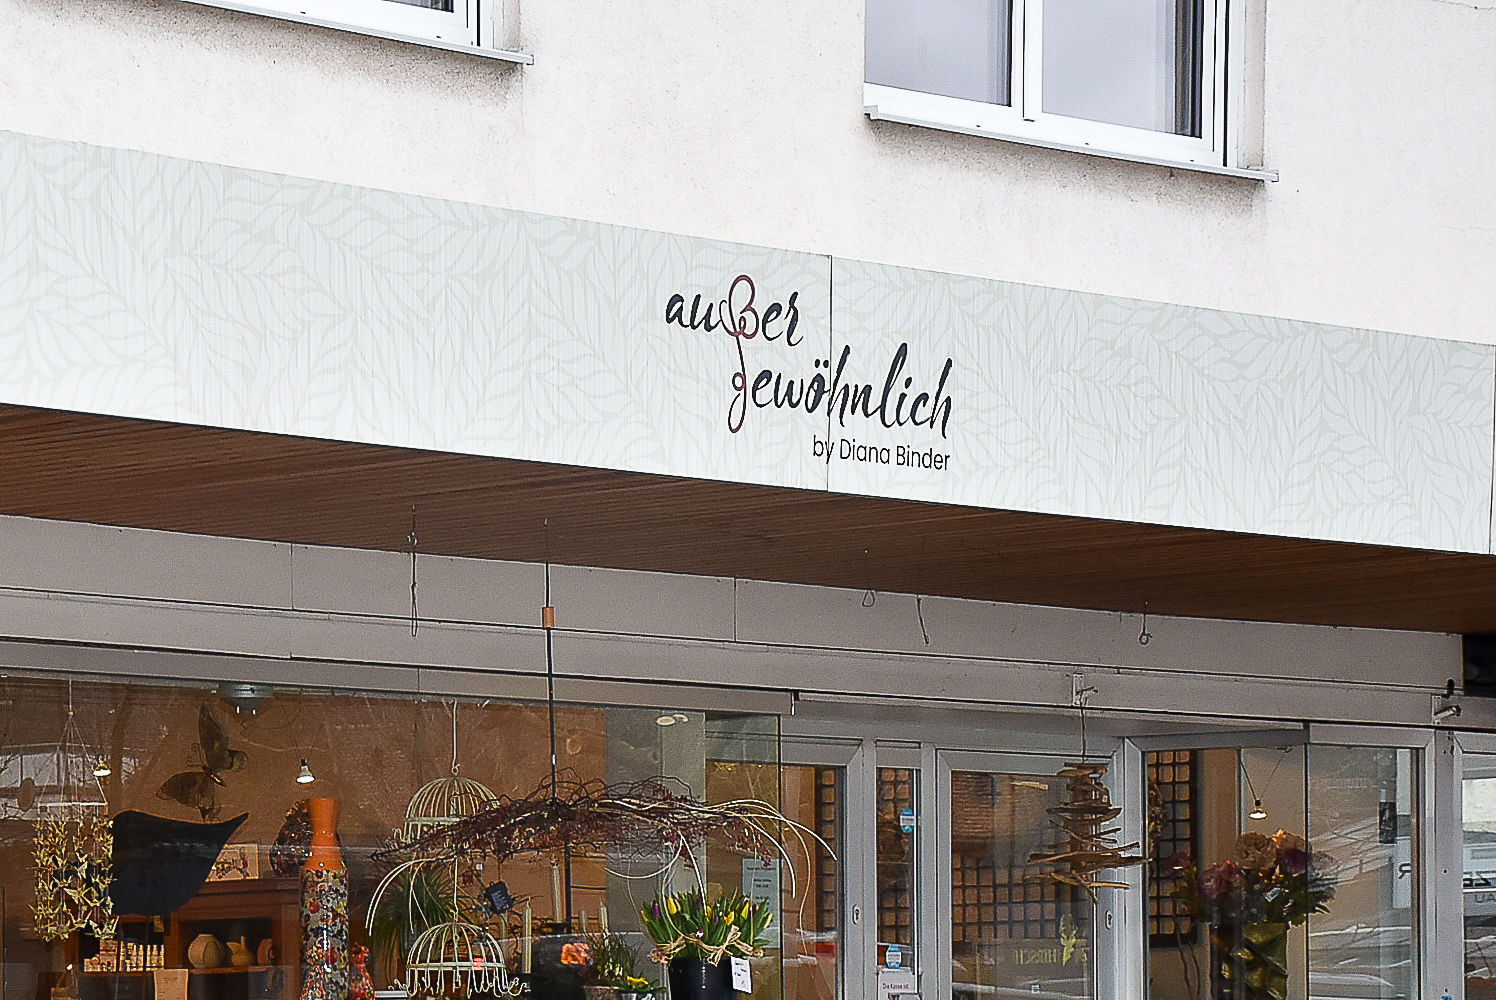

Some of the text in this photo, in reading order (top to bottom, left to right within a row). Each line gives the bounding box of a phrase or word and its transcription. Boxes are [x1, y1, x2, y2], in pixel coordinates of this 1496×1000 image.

[665, 274, 804, 348] außer
[727, 342, 953, 439] gewöhnlich
[812, 434, 952, 472] by Diana Binder
